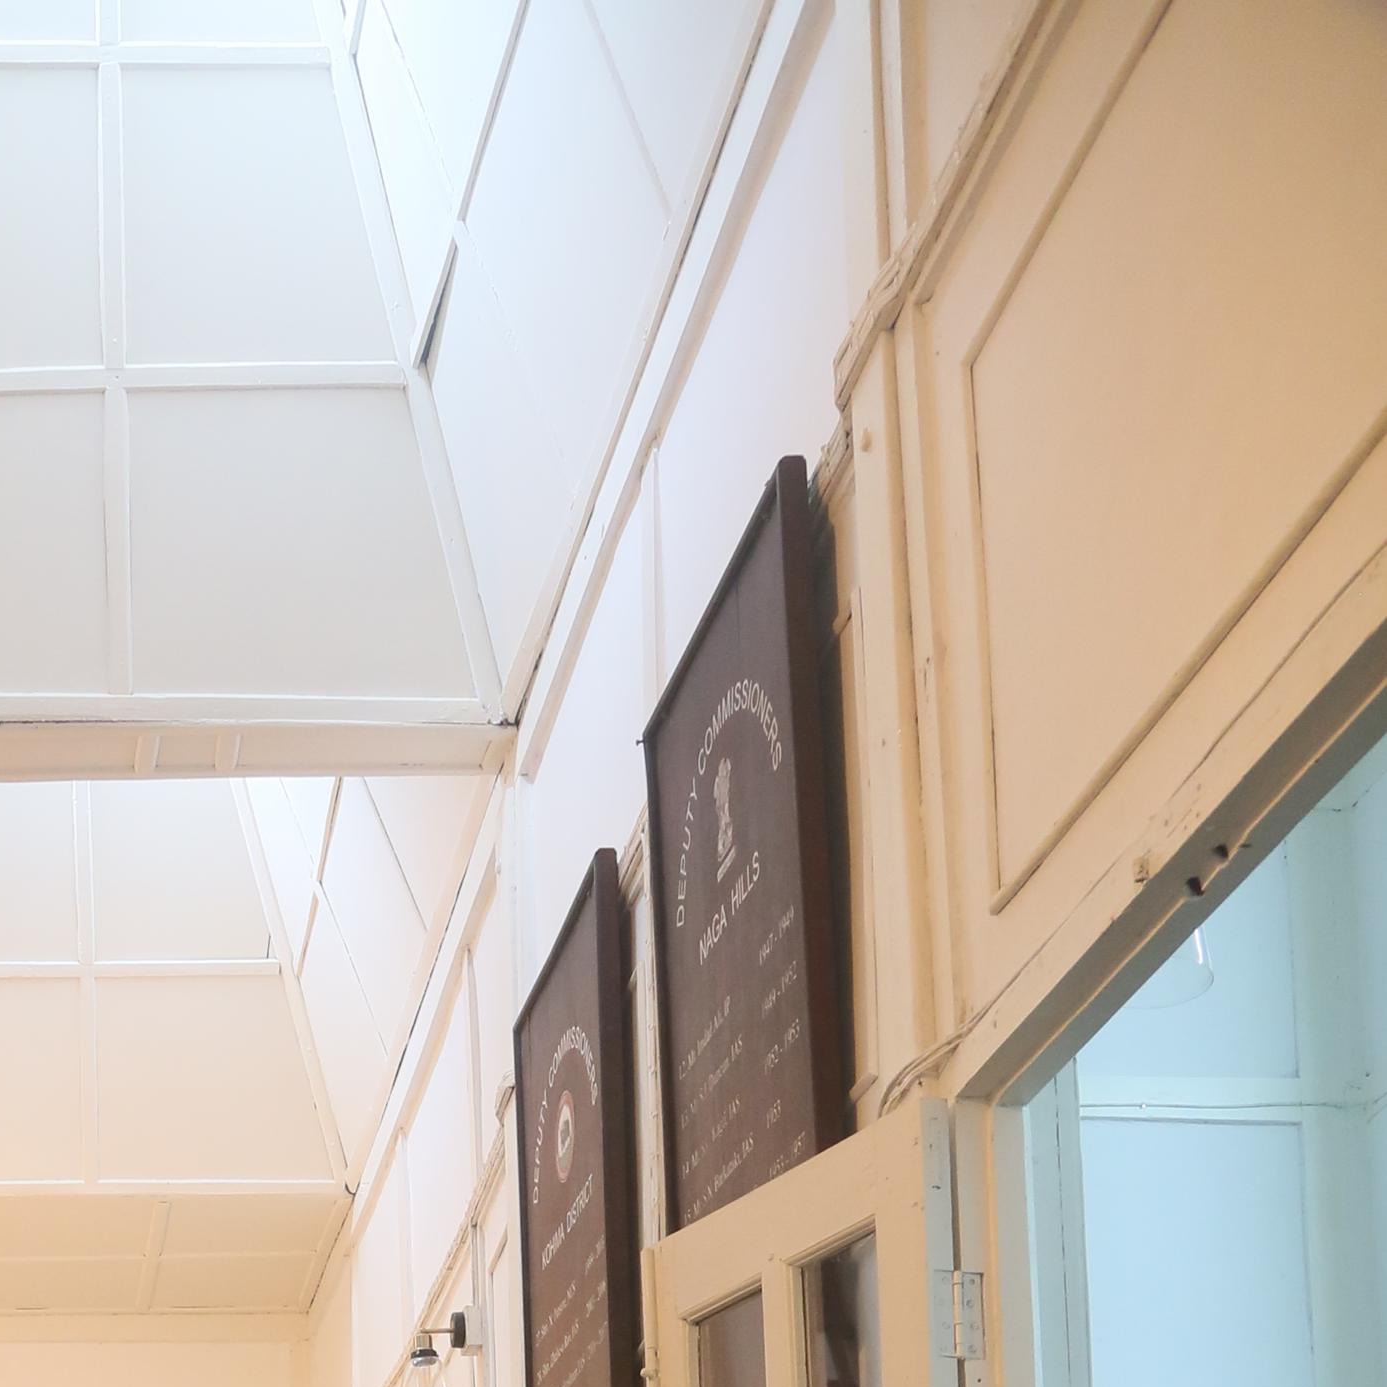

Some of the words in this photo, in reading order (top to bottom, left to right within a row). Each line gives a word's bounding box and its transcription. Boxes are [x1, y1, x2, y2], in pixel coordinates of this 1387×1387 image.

[675, 777, 700, 928] DEPUTY
[698, 677, 782, 771] COMMISSIONERS
[699, 903, 727, 966] NAGA
[730, 850, 761, 916] HILLS
[730, 1030, 743, 1063] IAS
[533, 1088, 549, 1206] DEPUTY
[548, 1024, 598, 1106] COMMISSIONERS
[542, 1222, 567, 1271] KOHIMA
[566, 1173, 594, 1236] DISTRICT
